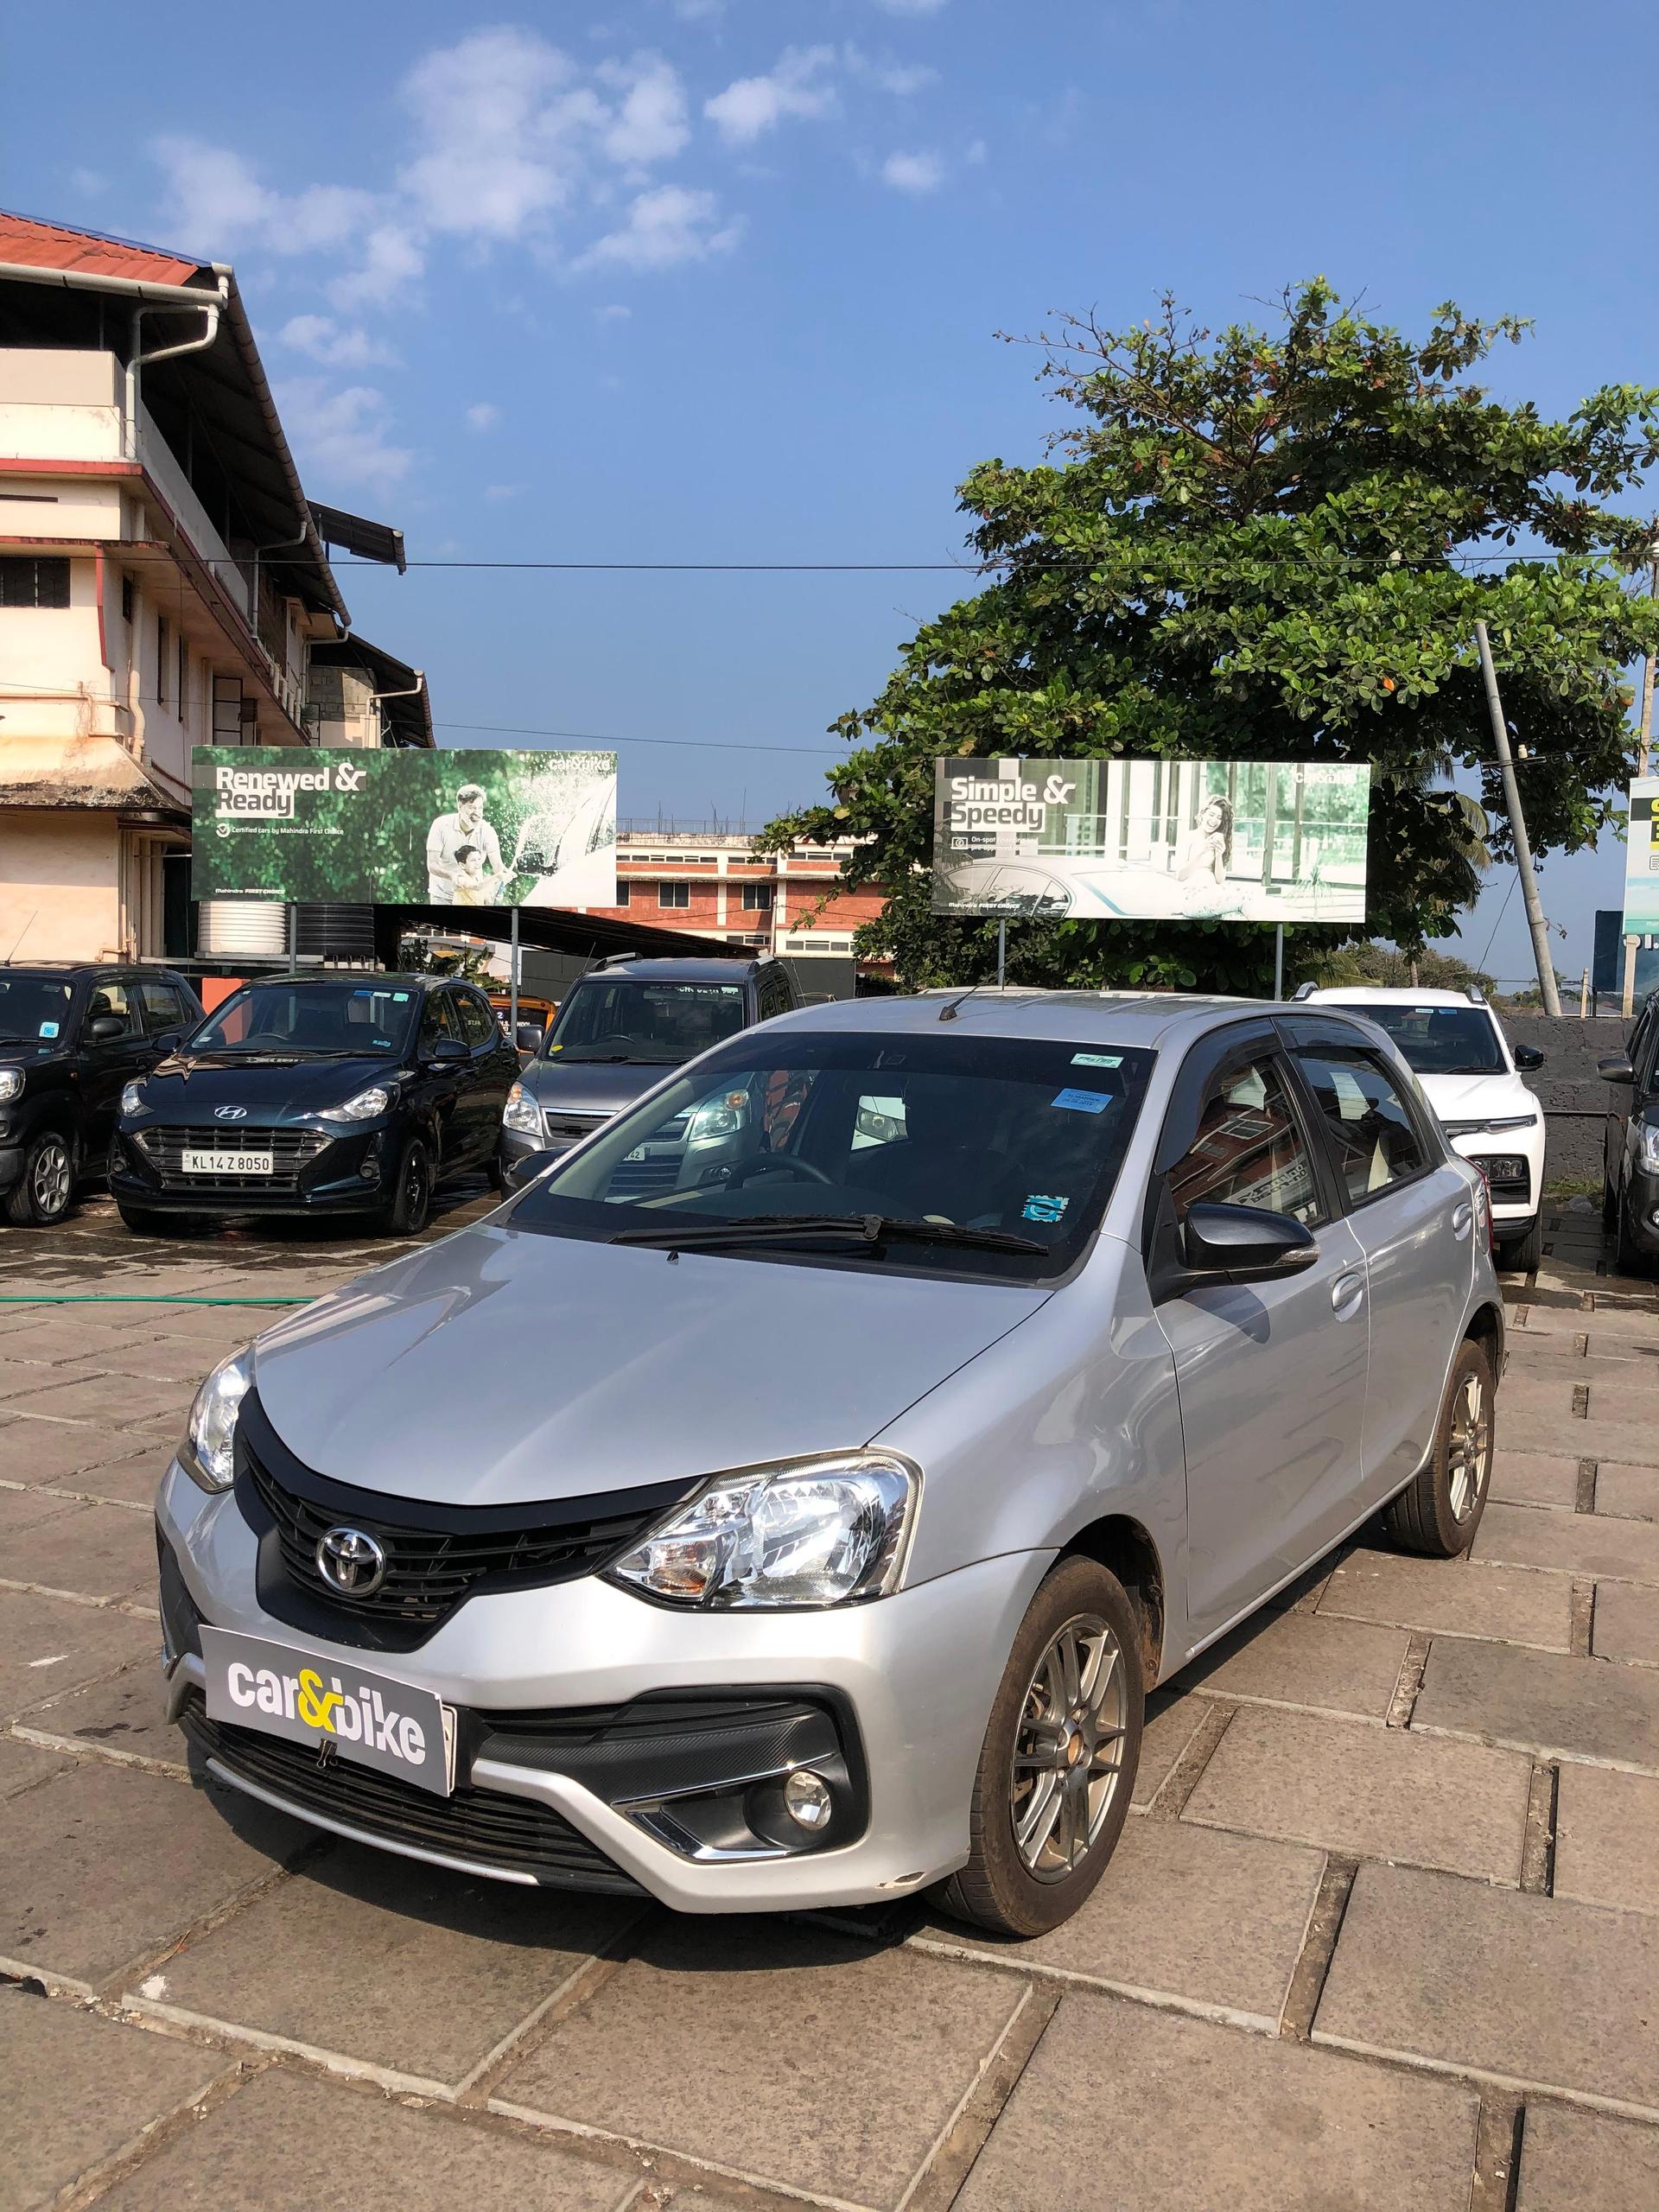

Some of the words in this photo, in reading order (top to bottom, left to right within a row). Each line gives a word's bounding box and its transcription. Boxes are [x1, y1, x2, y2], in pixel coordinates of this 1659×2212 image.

[216, 767, 330, 791] Renewed
[334, 762, 367, 791] &
[951, 776, 1037, 803] Simple
[1043, 775, 1077, 804] &
[216, 789, 291, 817] Ready
[950, 802, 1043, 830] Speedy
[324, 827, 344, 836] Choice
[971, 836, 995, 844] On-spot
[192, 1155, 207, 1169] KL
[209, 1156, 224, 1169] 14
[227, 1157, 235, 1170] Z
[238, 1157, 270, 1171] 8050
[227, 1662, 427, 1766] car&bike
